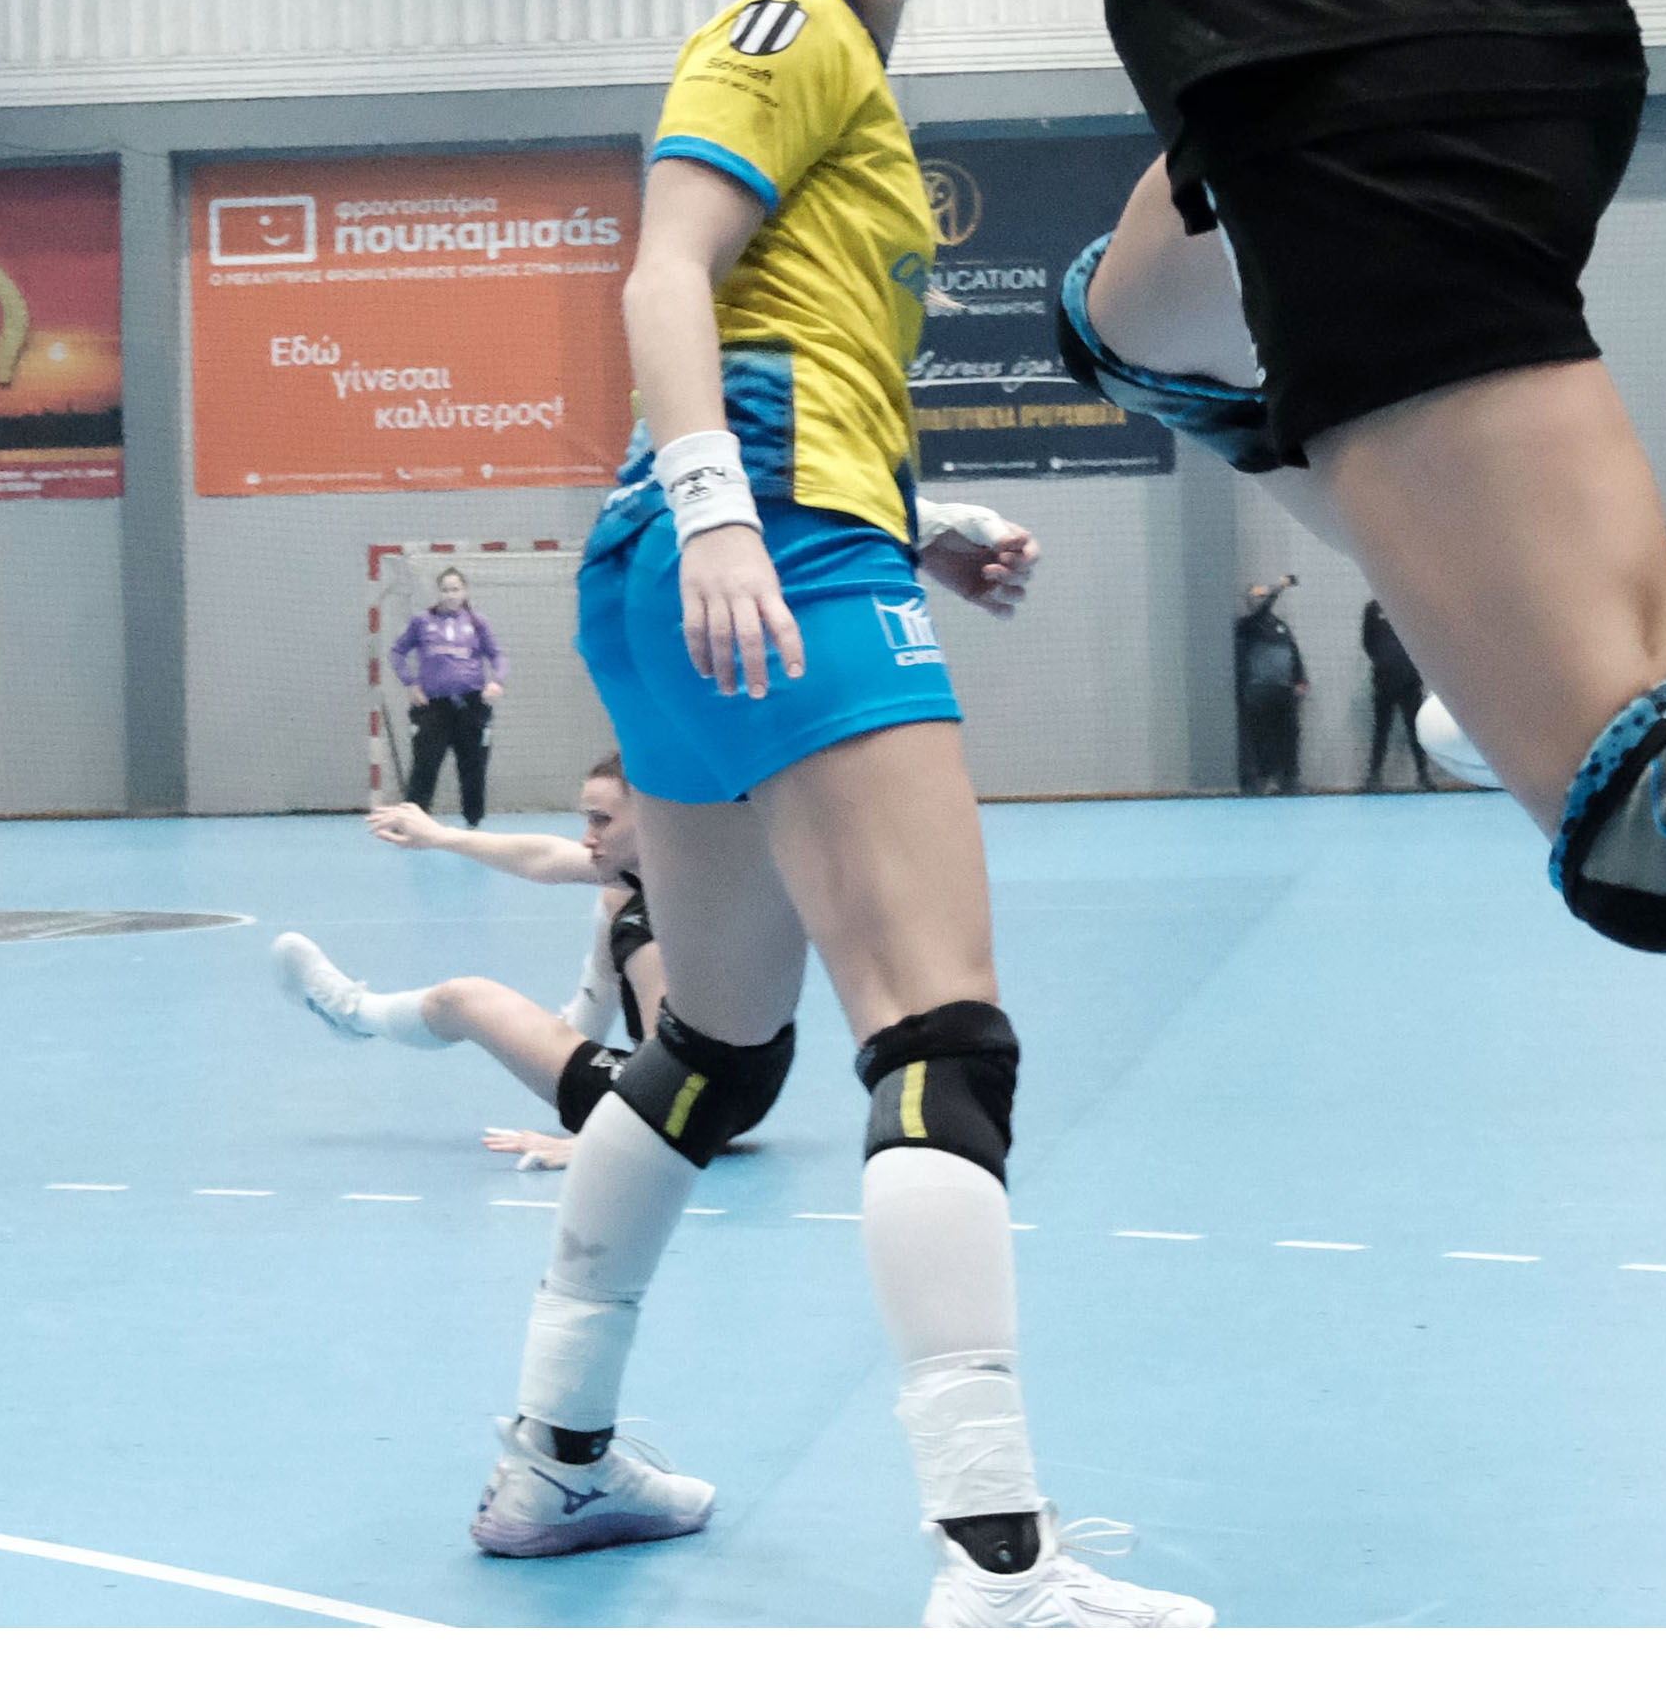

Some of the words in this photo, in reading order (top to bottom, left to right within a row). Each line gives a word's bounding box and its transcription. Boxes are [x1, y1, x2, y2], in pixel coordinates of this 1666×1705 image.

[269, 334, 342, 367] Εδώ
[331, 360, 453, 400] γίνεσαι
[374, 394, 566, 431] καλύτερος!
